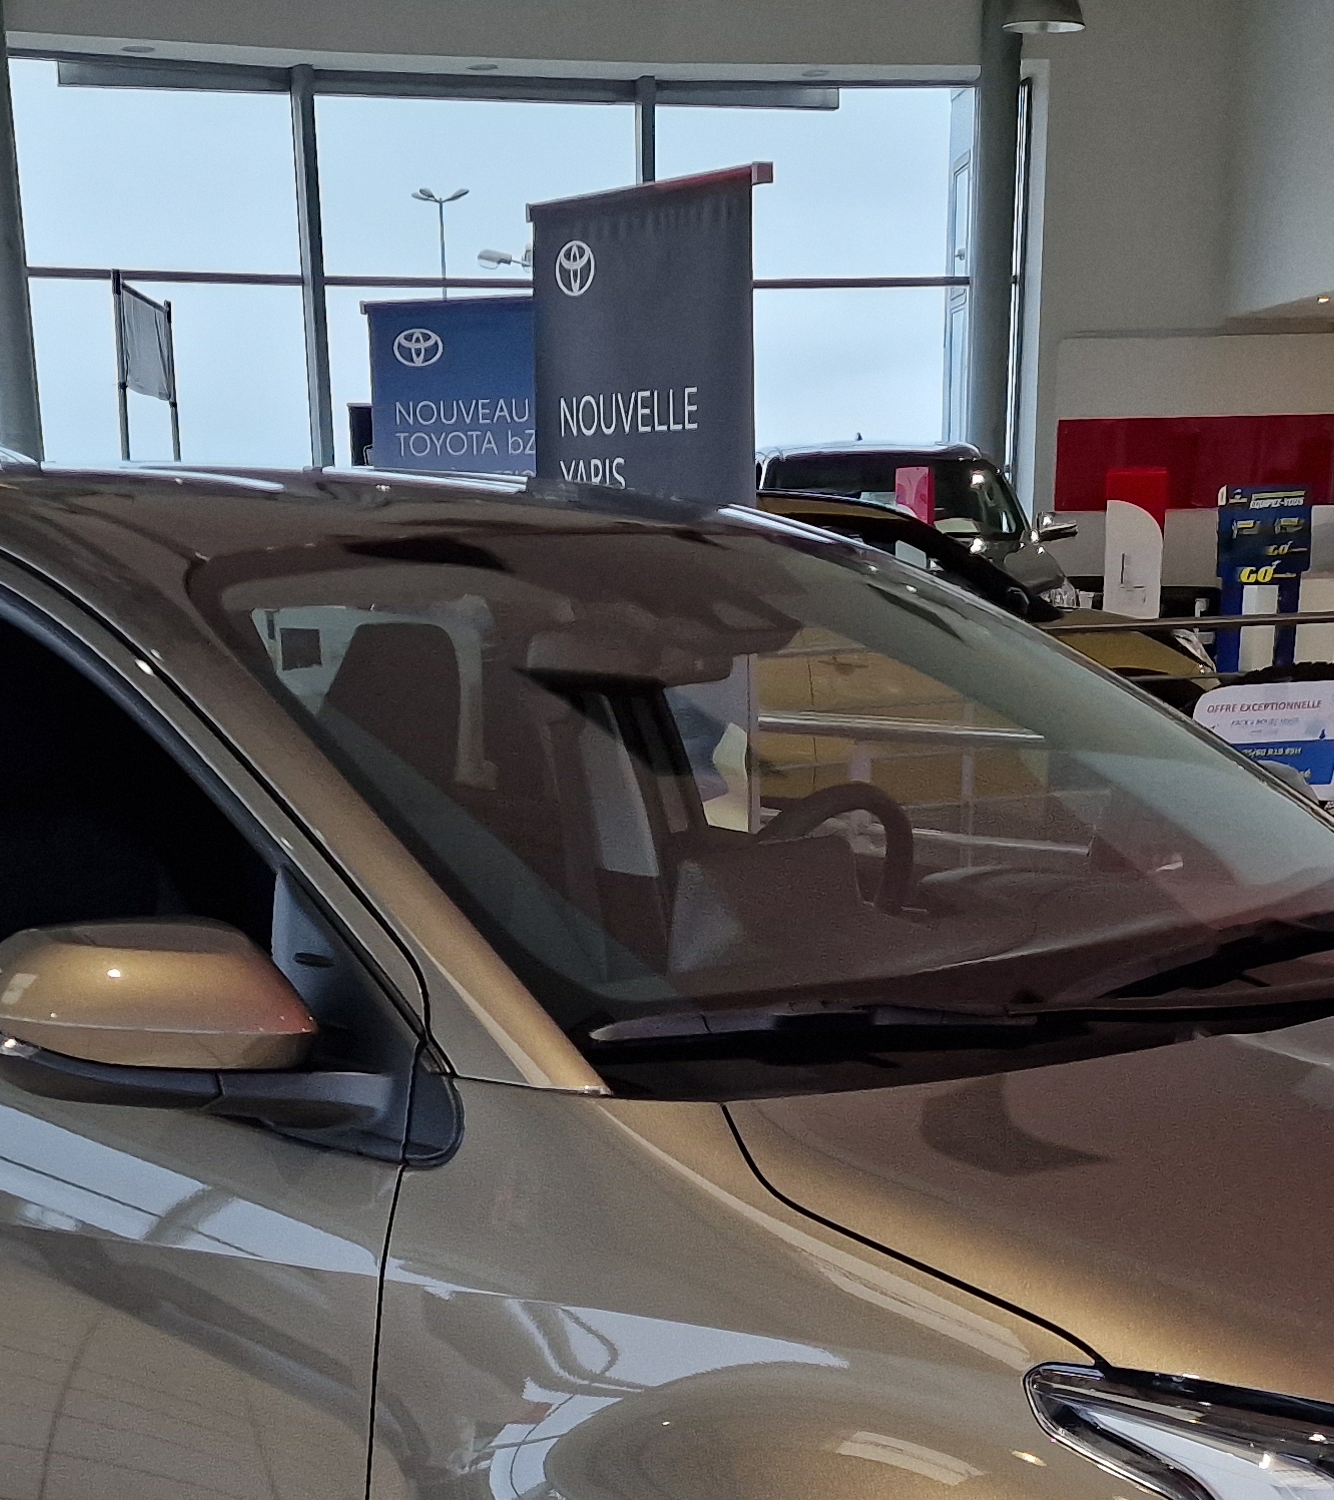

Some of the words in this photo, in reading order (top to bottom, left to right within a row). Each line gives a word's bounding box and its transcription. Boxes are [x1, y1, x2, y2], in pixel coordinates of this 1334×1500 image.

[395, 398, 530, 426] NOUVEAU
[559, 386, 698, 438] NOUVELLE
[395, 431, 499, 457] TOYOTA
[1207, 703, 1237, 714] OFFRE
[1240, 700, 1323, 712] EXCEPTIONNELLE
